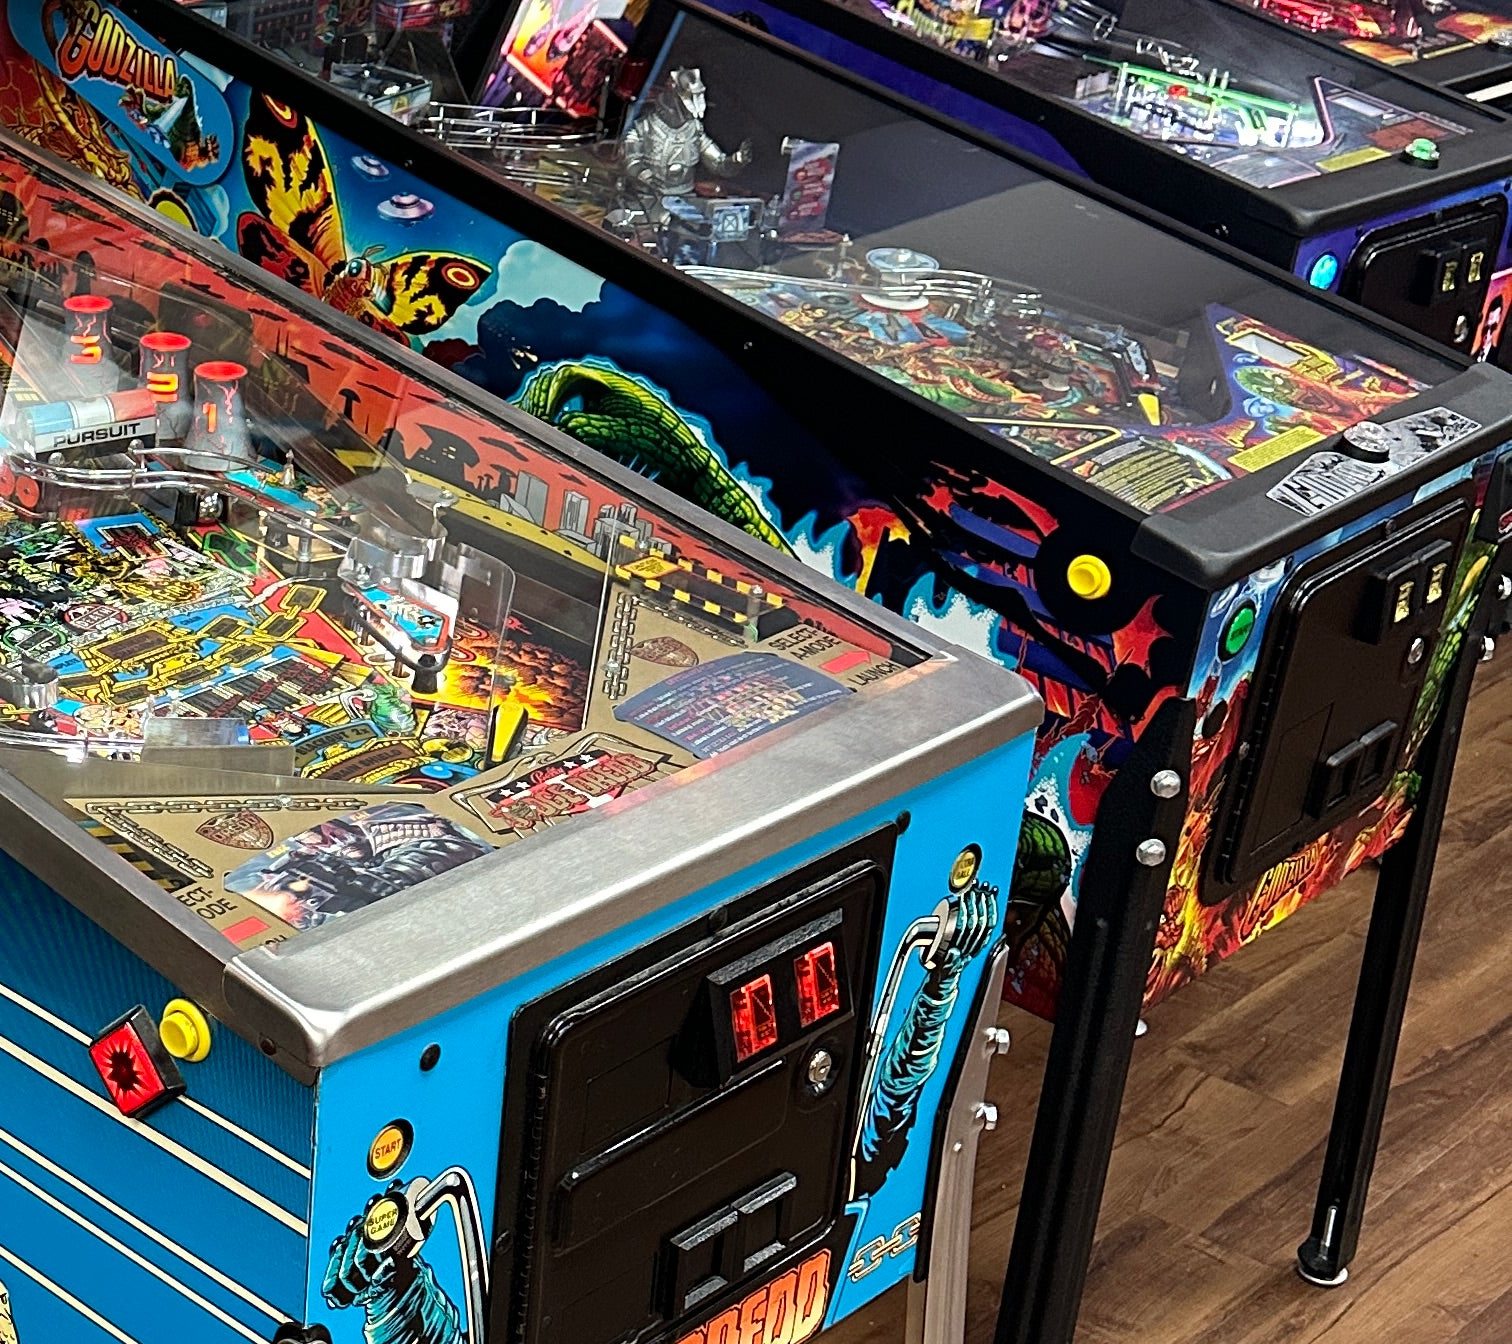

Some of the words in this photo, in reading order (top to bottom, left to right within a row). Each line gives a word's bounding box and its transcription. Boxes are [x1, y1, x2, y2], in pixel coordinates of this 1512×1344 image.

[60, 0, 175, 97] GODZILLA
[202, 402, 217, 434] 1
[53, 422, 142, 449] PURSUIT
[847, 660, 905, 687] LAUNCH
[295, 729, 349, 757] BLACKOUT
[336, 762, 361, 781] RAIN
[361, 748, 404, 771] SHIELD
[176, 887, 215, 908] ECT-
[1239, 842, 1320, 936] GODZILLA
[196, 897, 239, 921] ODE
[374, 1138, 402, 1160] START
[368, 1207, 398, 1227] SUPER
[370, 1218, 396, 1235] GAME
